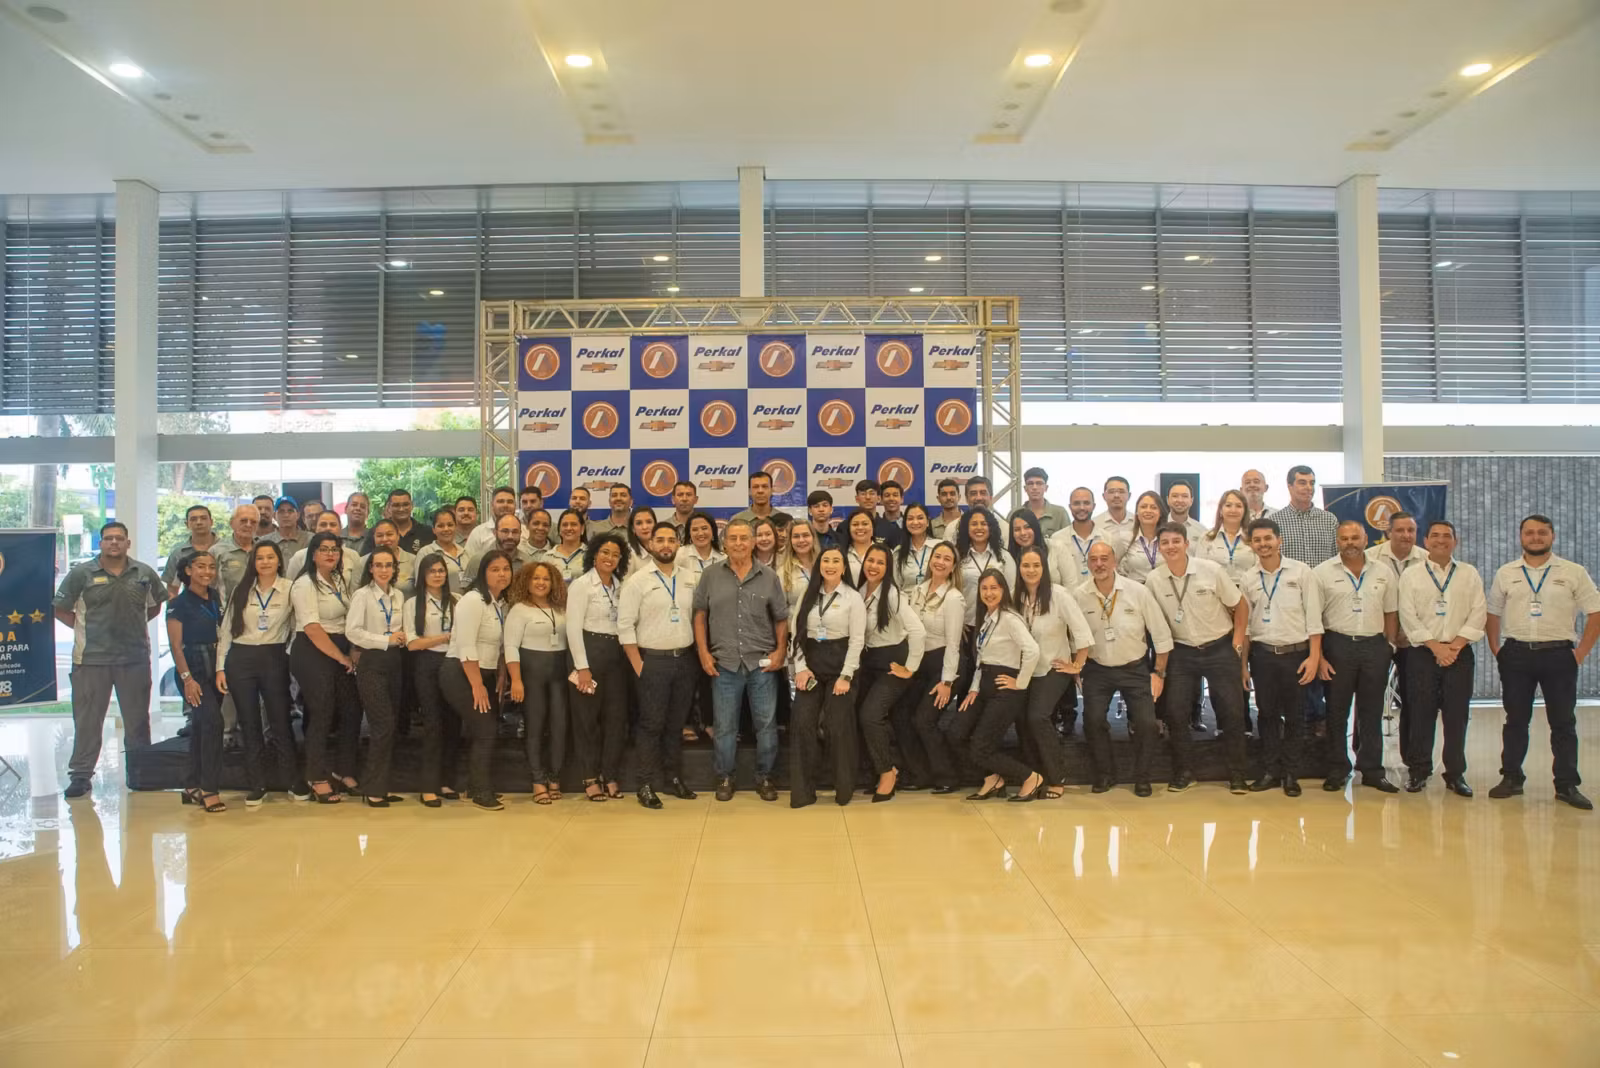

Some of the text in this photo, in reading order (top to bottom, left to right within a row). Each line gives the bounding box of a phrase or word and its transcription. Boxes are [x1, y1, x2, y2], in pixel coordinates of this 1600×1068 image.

[576, 347, 625, 359] Perkal
[693, 346, 743, 357] Perkal
[811, 345, 860, 356] Perkal
[928, 345, 976, 356] Perkal
[518, 407, 567, 418] Perkal
[635, 406, 684, 417] Perkal
[753, 405, 802, 416] Perkal
[870, 404, 919, 415] Perkal
[576, 466, 626, 477] Perkal
[694, 464, 744, 476] Perkal
[812, 463, 861, 474] Perkal
[929, 462, 978, 474] Perkal
[7, 643, 30, 652] PARA
